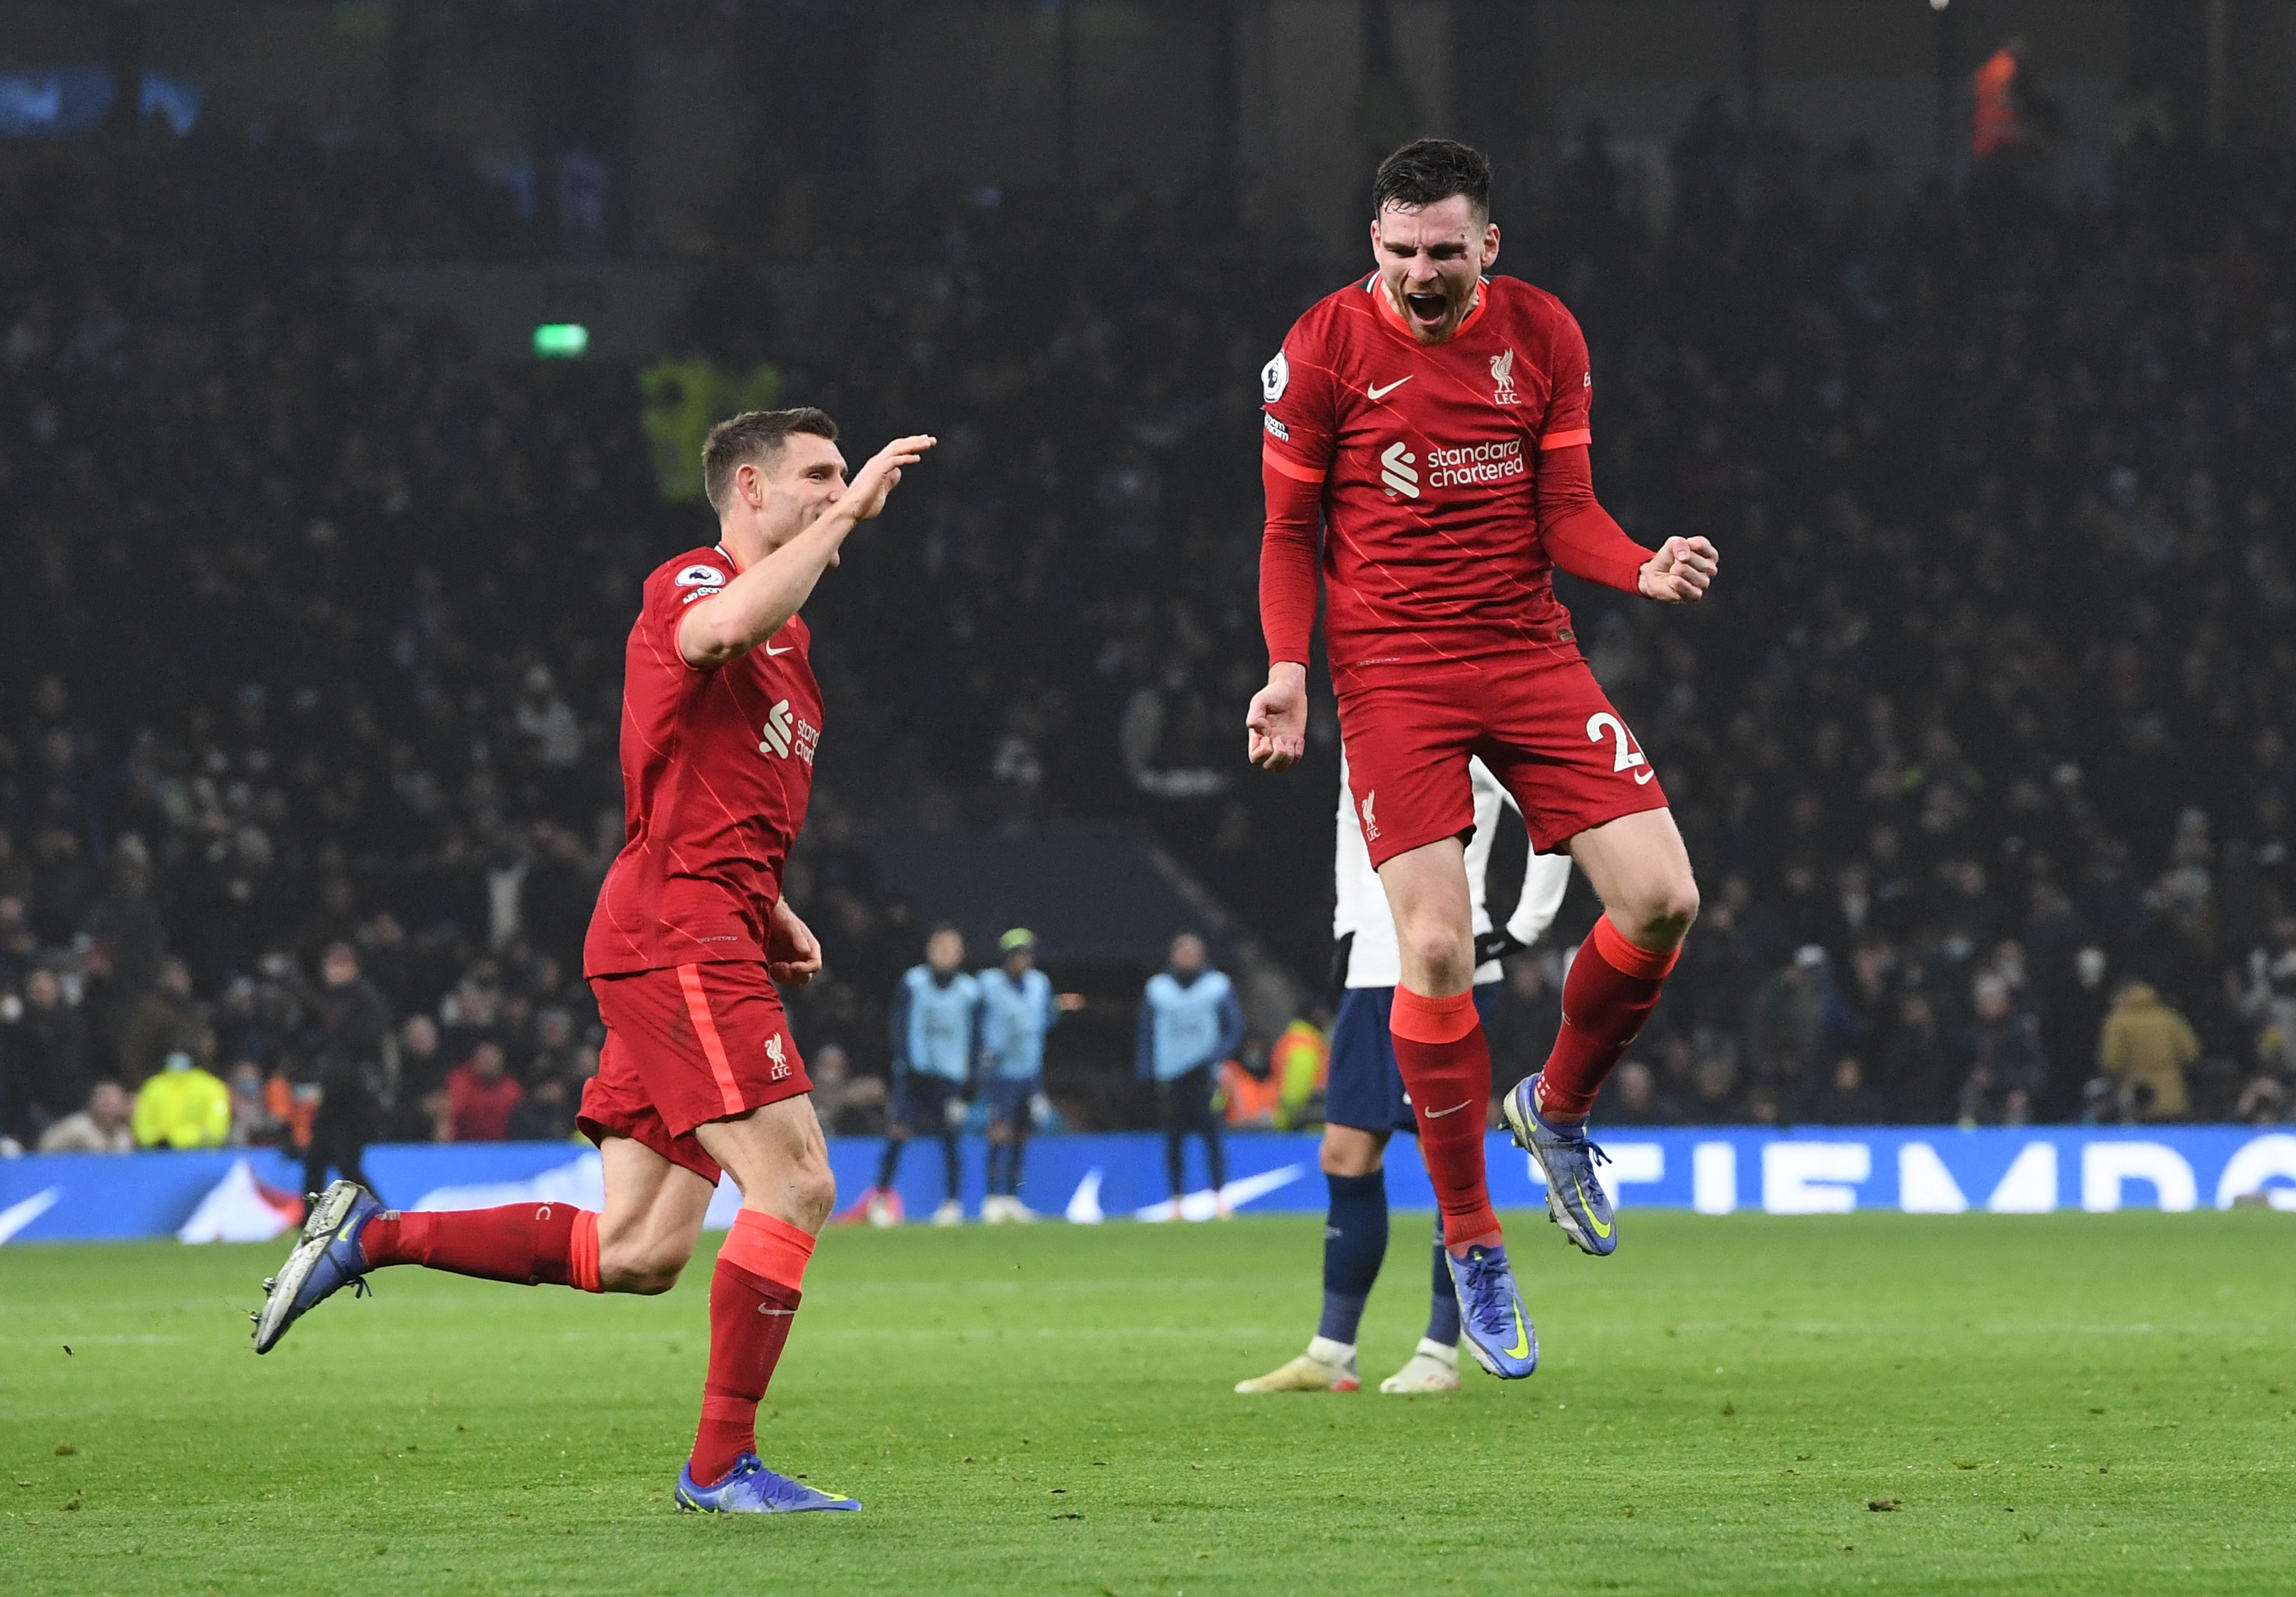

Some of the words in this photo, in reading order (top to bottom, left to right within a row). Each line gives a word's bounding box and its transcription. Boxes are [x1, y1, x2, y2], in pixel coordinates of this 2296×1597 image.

[1428, 437, 1522, 468] standard
[1429, 453, 1524, 487] chartered
[1587, 712, 1647, 772] 2
